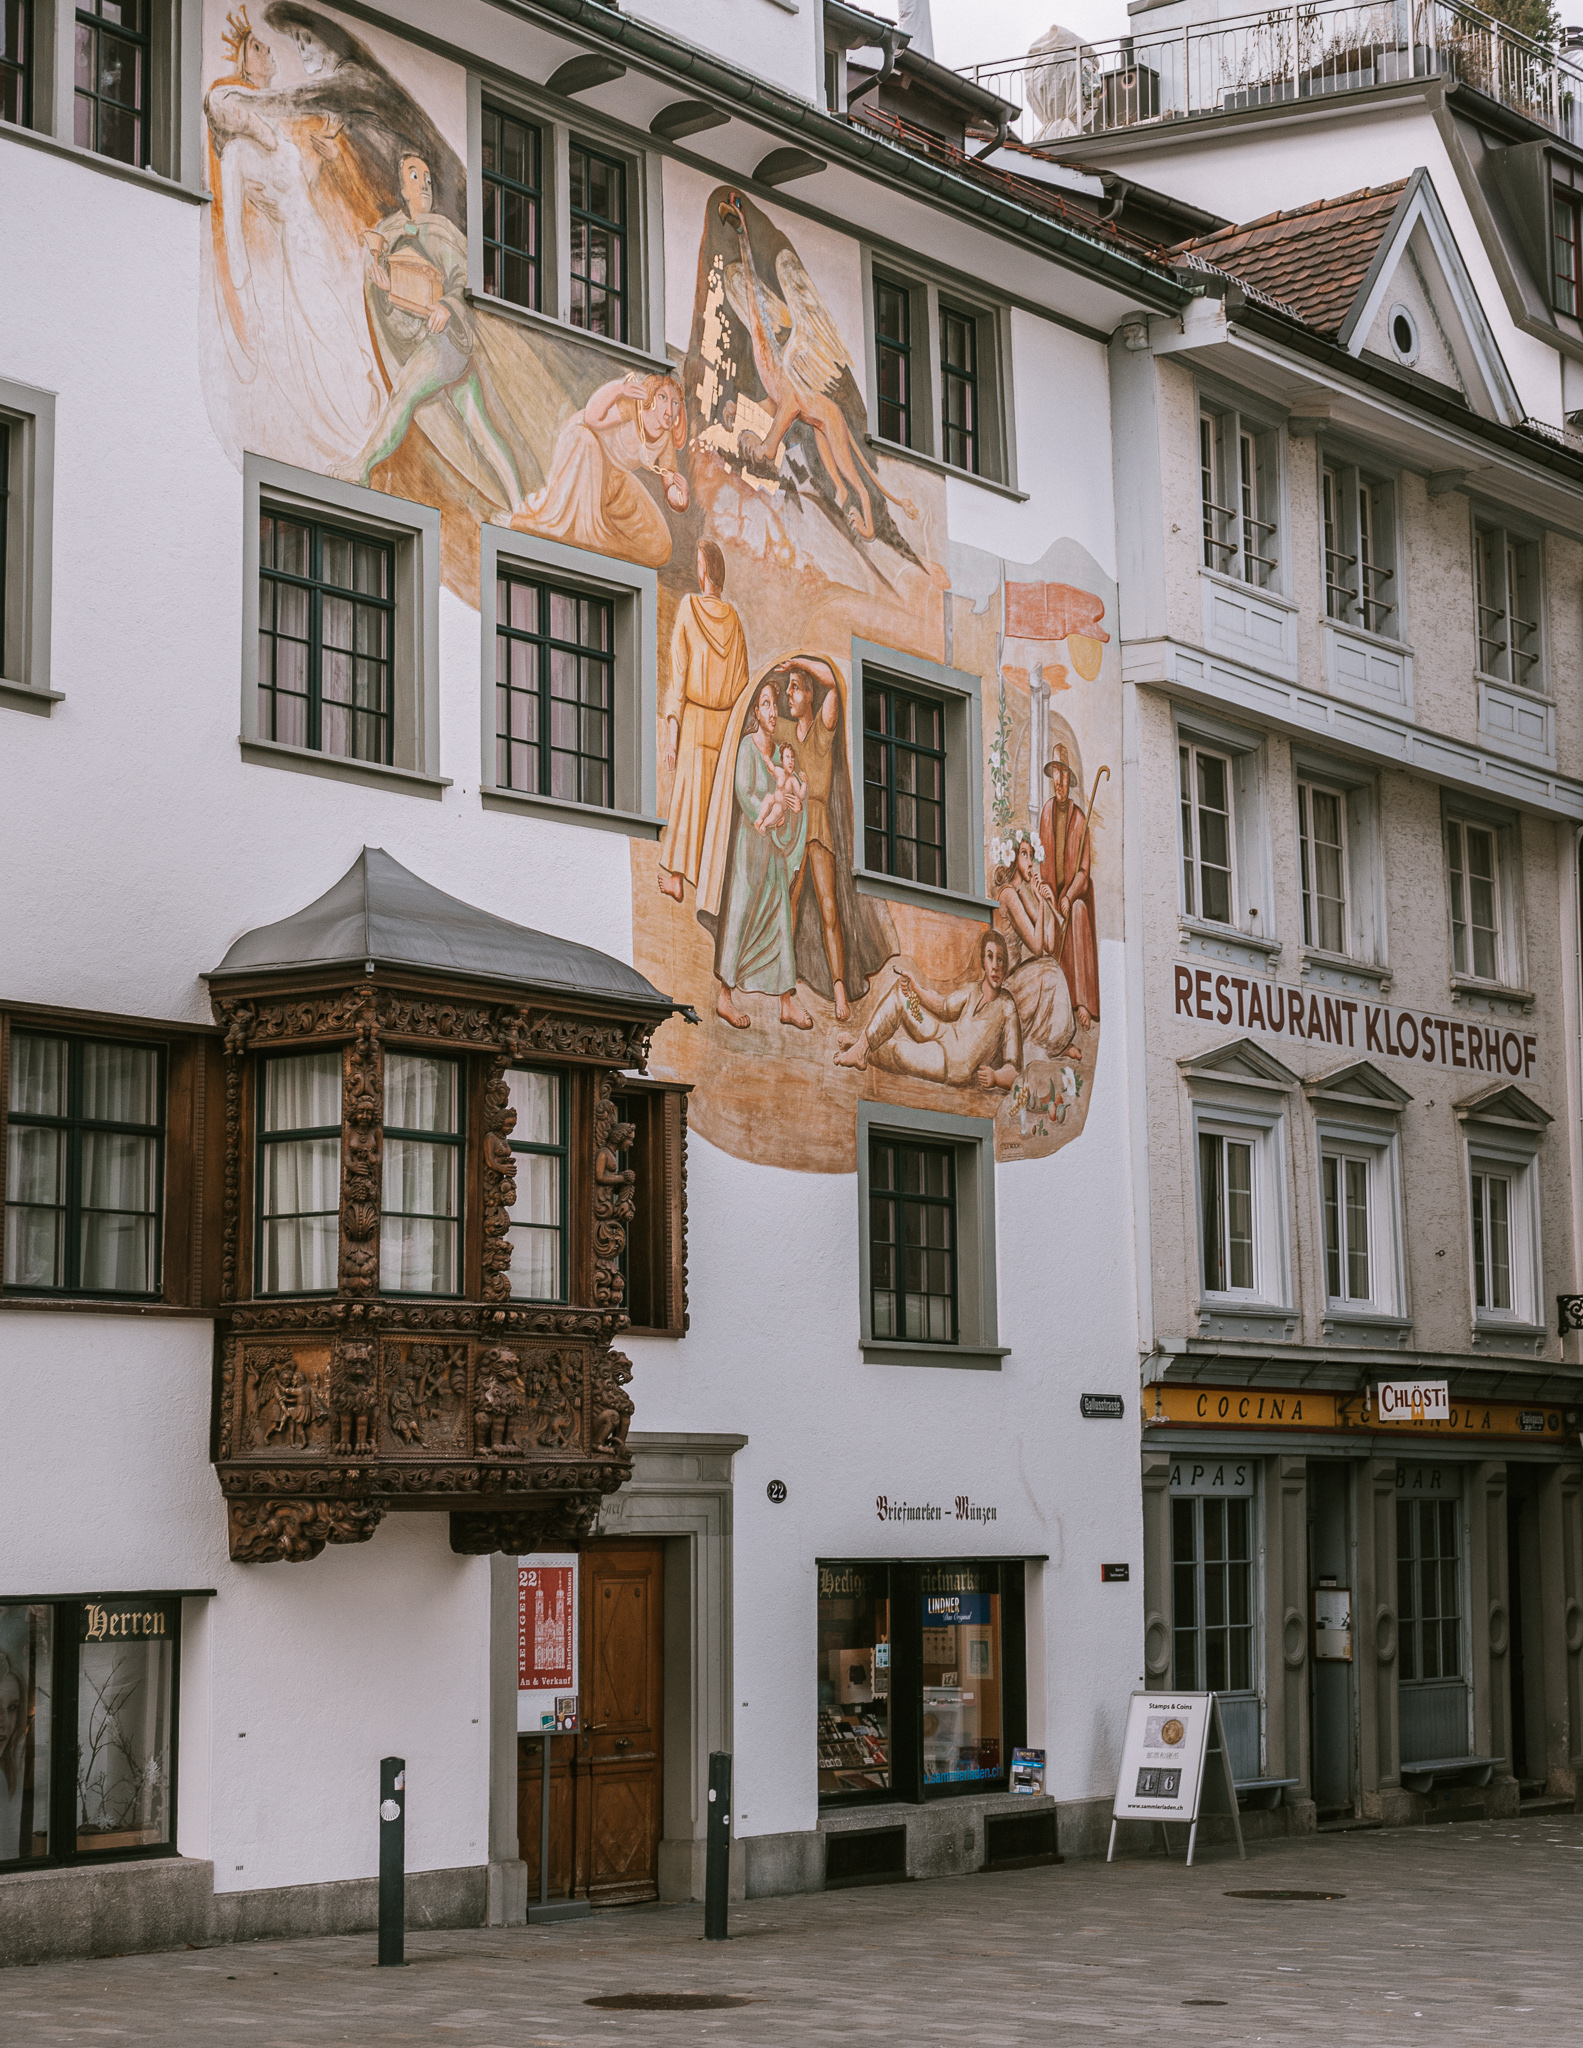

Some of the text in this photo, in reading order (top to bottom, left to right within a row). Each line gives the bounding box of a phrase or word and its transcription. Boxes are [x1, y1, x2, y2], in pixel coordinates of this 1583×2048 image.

[1174, 964, 1537, 1079] RESTAURANT KLOSTERHOF
[1084, 1397, 1121, 1411] Gallusstrasse
[1196, 1393, 1303, 1420] COCINA
[1169, 1464, 1247, 1486] APAS
[1395, 1466, 1442, 1489] BAR
[771, 1483, 785, 1499] 22
[876, 1495, 942, 1526] Briefmarken
[954, 1495, 997, 1526] Münzen
[519, 1571, 538, 1587] 22
[819, 1567, 988, 1598] Hediger riefmarken
[927, 1597, 960, 1614] LINDNER
[84, 1604, 166, 1641] Herren
[953, 1611, 973, 1623] Original
[520, 1676, 571, 1686] An & Verkauf
[1148, 1703, 1170, 1711] Stamps
[1127, 1803, 1184, 1811] www.sammlerladen.ch
